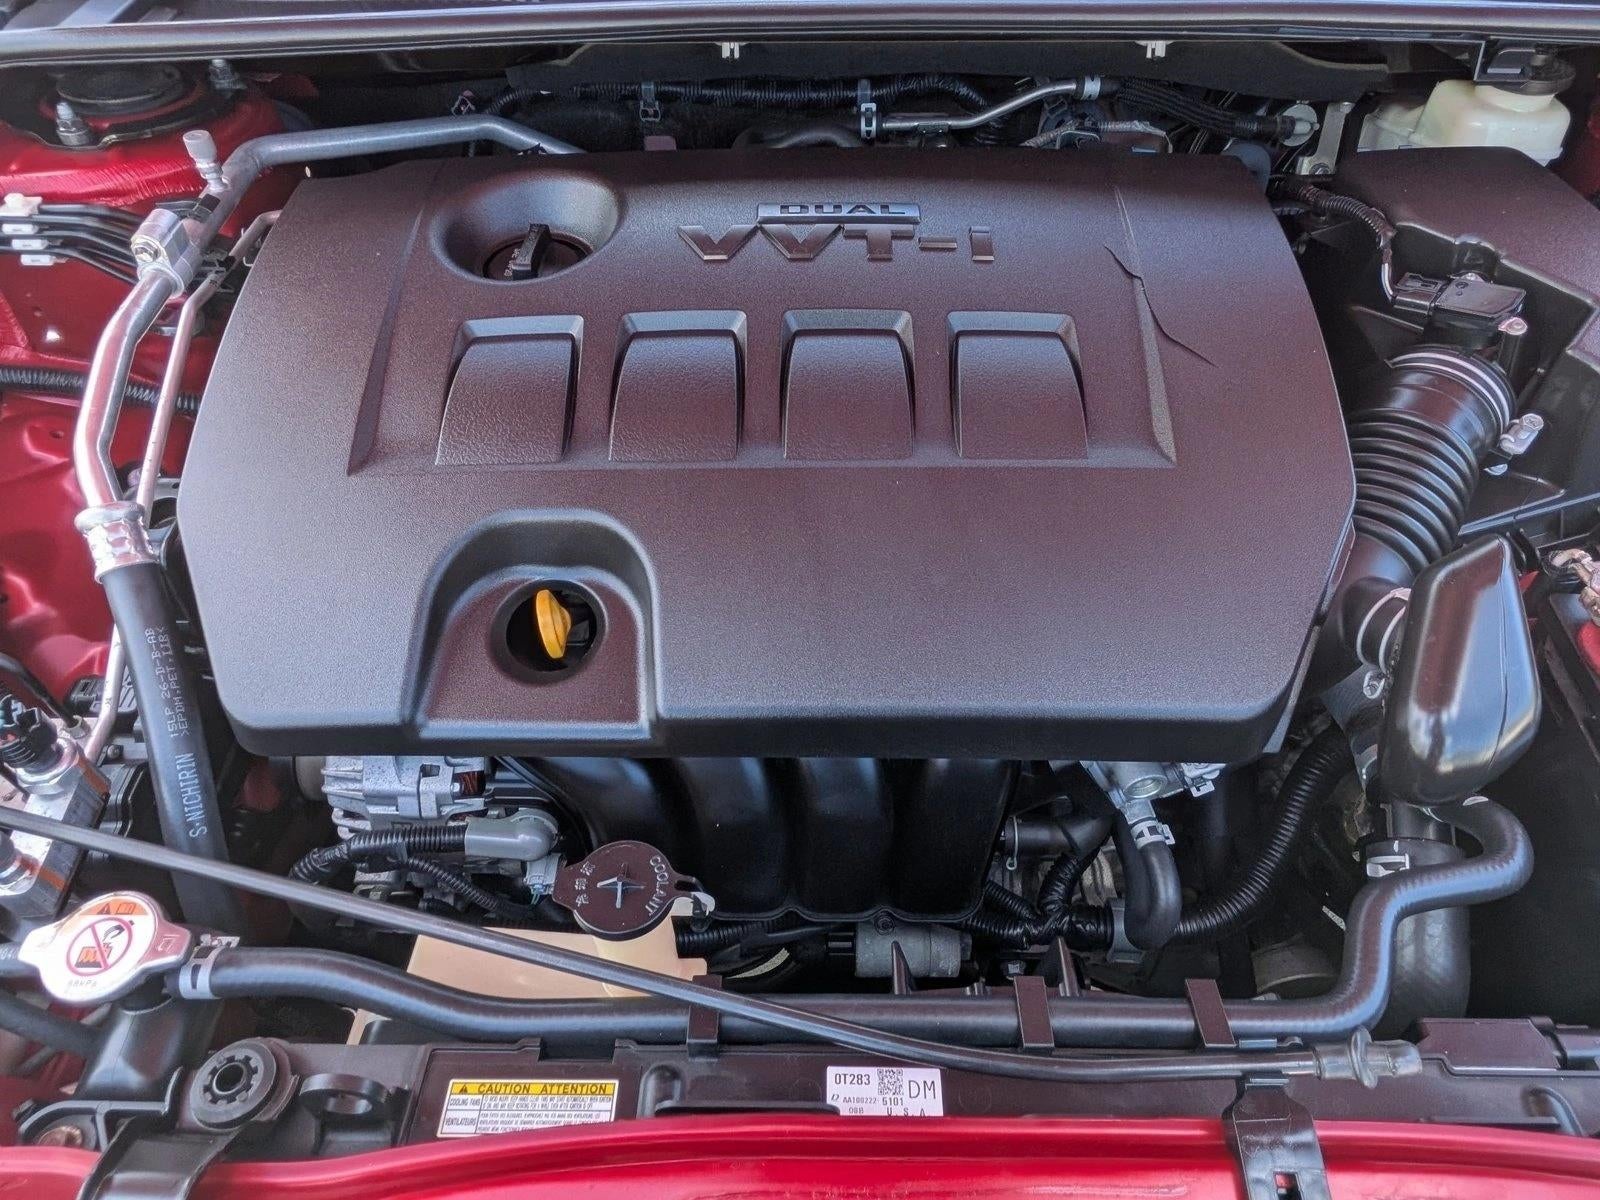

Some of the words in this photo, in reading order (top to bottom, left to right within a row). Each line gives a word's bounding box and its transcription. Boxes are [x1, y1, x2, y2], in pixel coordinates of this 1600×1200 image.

[780, 204, 905, 215] DUAL
[645, 855, 669, 916] COOLANT
[477, 1083, 530, 1095] CAUTION
[540, 1083, 607, 1095] ATTENTION
[908, 1079, 936, 1100] DM
[449, 1098, 469, 1107] COOLING
[469, 1098, 481, 1107] FANS
[445, 1117, 477, 1127] VENTILATEURS
